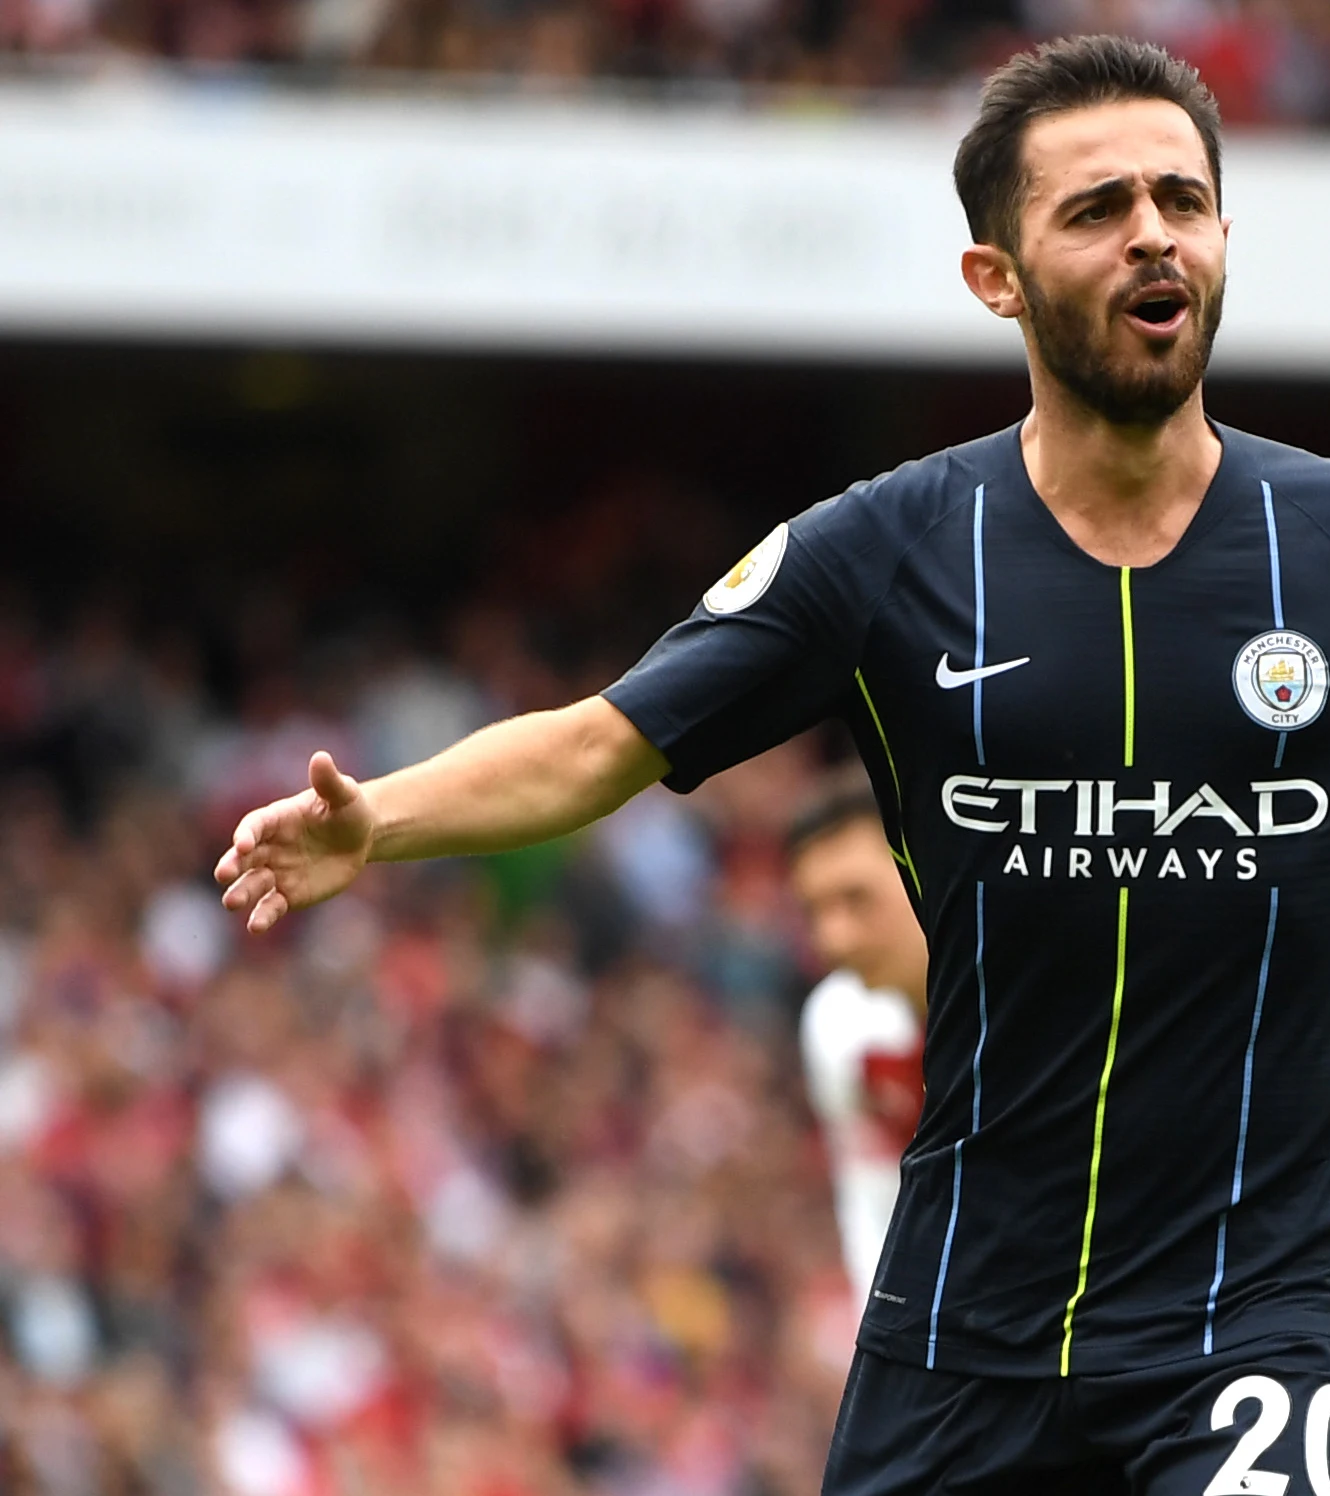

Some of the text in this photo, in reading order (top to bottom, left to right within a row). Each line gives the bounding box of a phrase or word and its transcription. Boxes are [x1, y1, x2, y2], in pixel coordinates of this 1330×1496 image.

[1243, 637, 1319, 664] MANCHESTER
[1271, 714, 1299, 723] CITY
[941, 775, 1329, 836] ETIHAD
[1003, 844, 1258, 880] AIRWAYS
